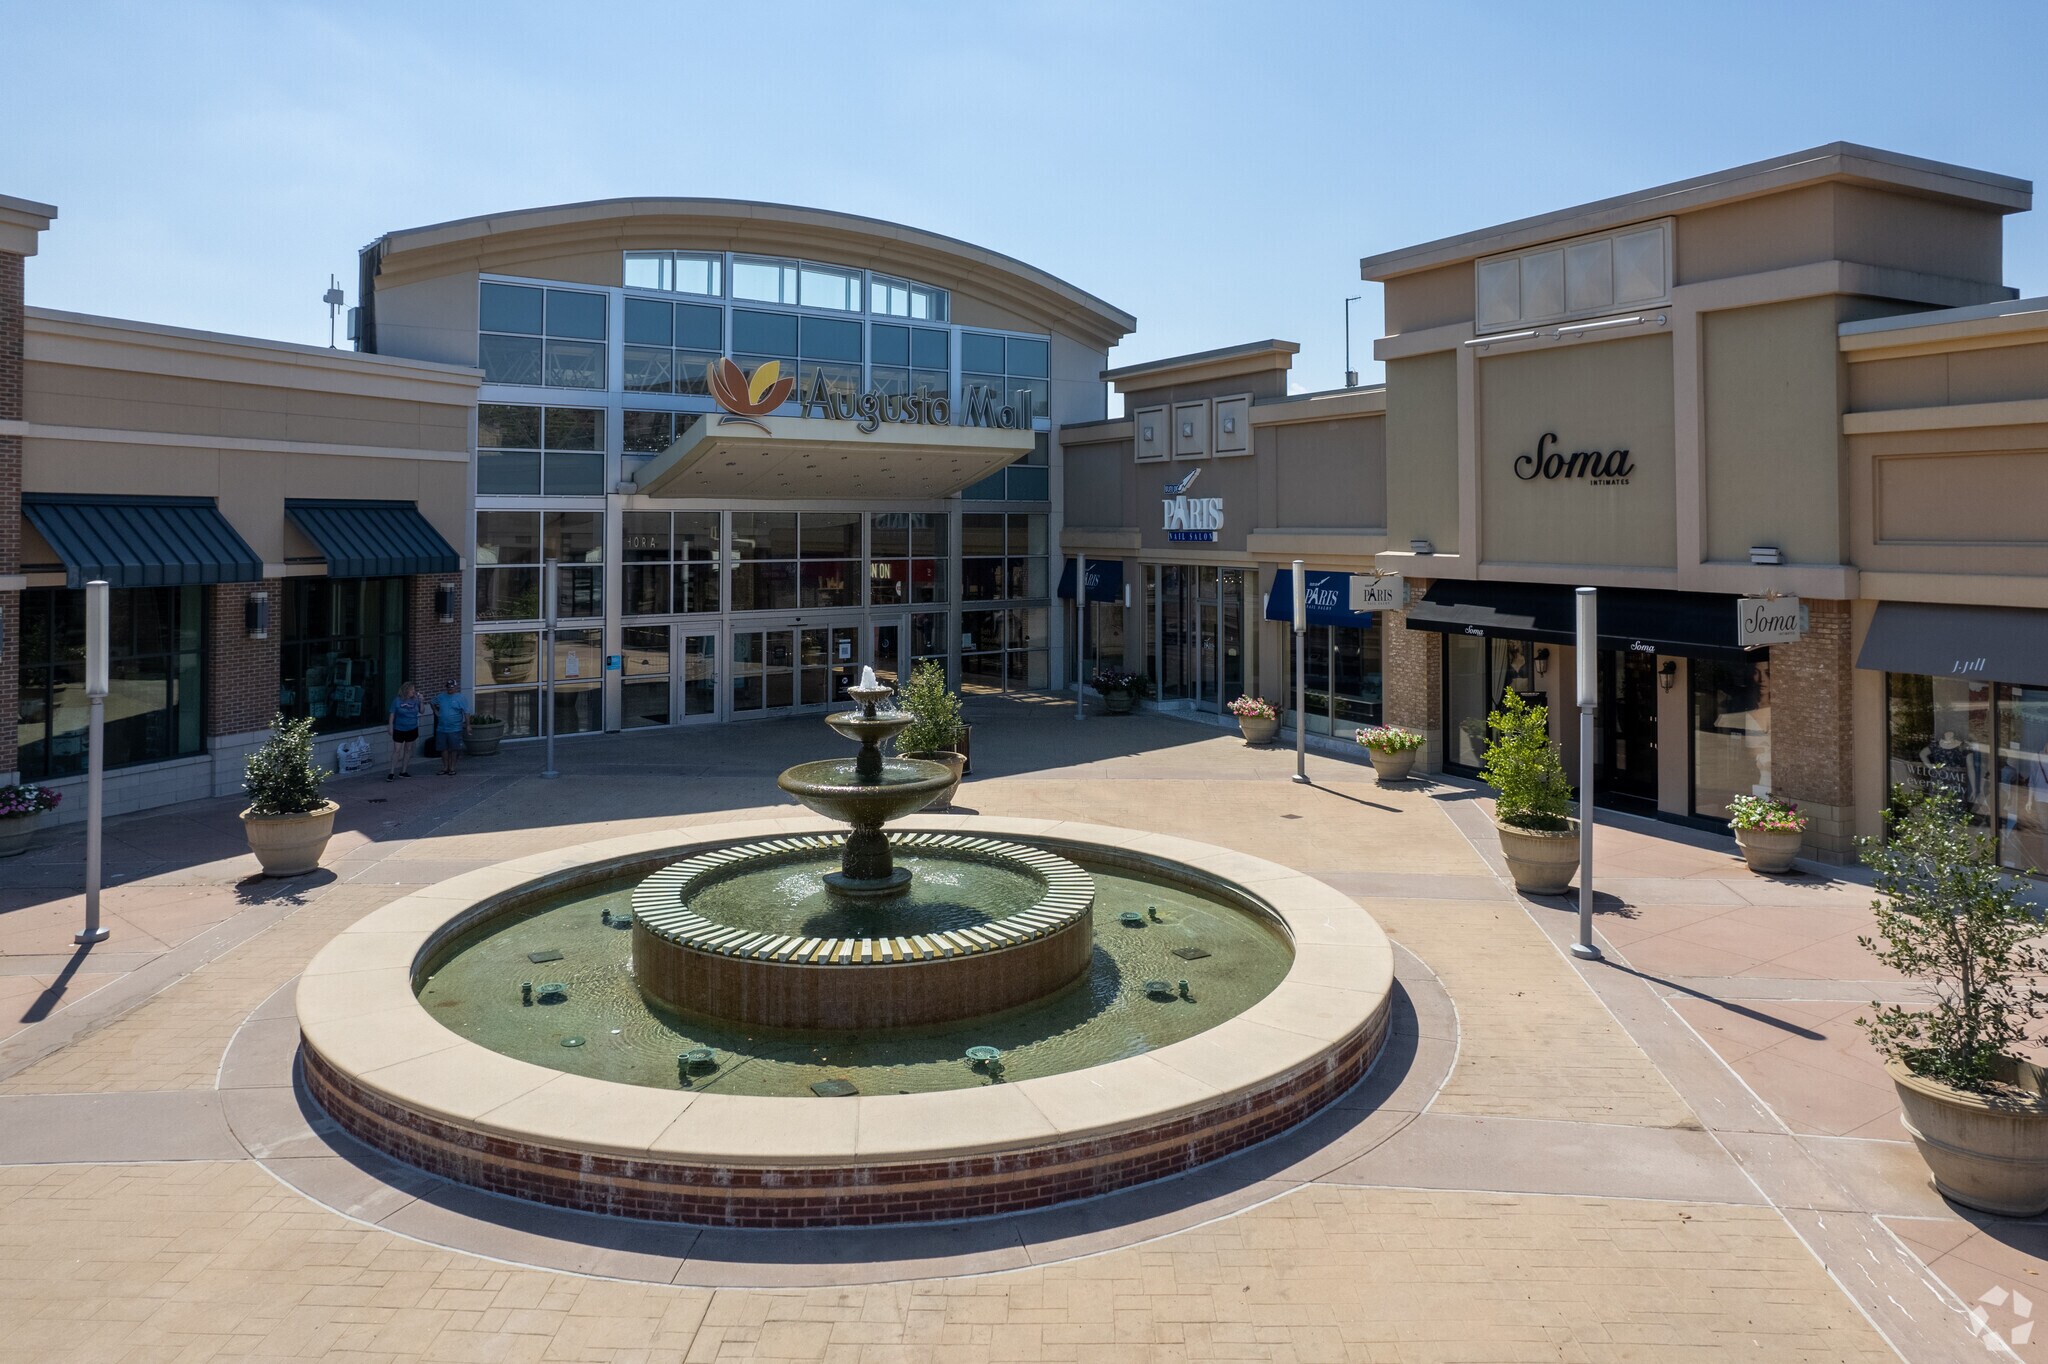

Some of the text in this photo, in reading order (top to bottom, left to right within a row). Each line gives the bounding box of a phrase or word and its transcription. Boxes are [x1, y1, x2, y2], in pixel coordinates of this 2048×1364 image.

[802, 366, 1034, 434] Augusta Mall
[1514, 432, 1635, 480] Soma
[1162, 495, 1224, 530] PARIS
[1168, 532, 1213, 541] NAIL SALON
[1305, 587, 1339, 606] PARIS
[1363, 588, 1393, 602] PARIS
[1745, 605, 1798, 634] Soma
[1464, 625, 1484, 635] Soma
[1630, 640, 1656, 651] Soma
[1906, 764, 1967, 784] WELCOME
[1907, 777, 1968, 796] everody
